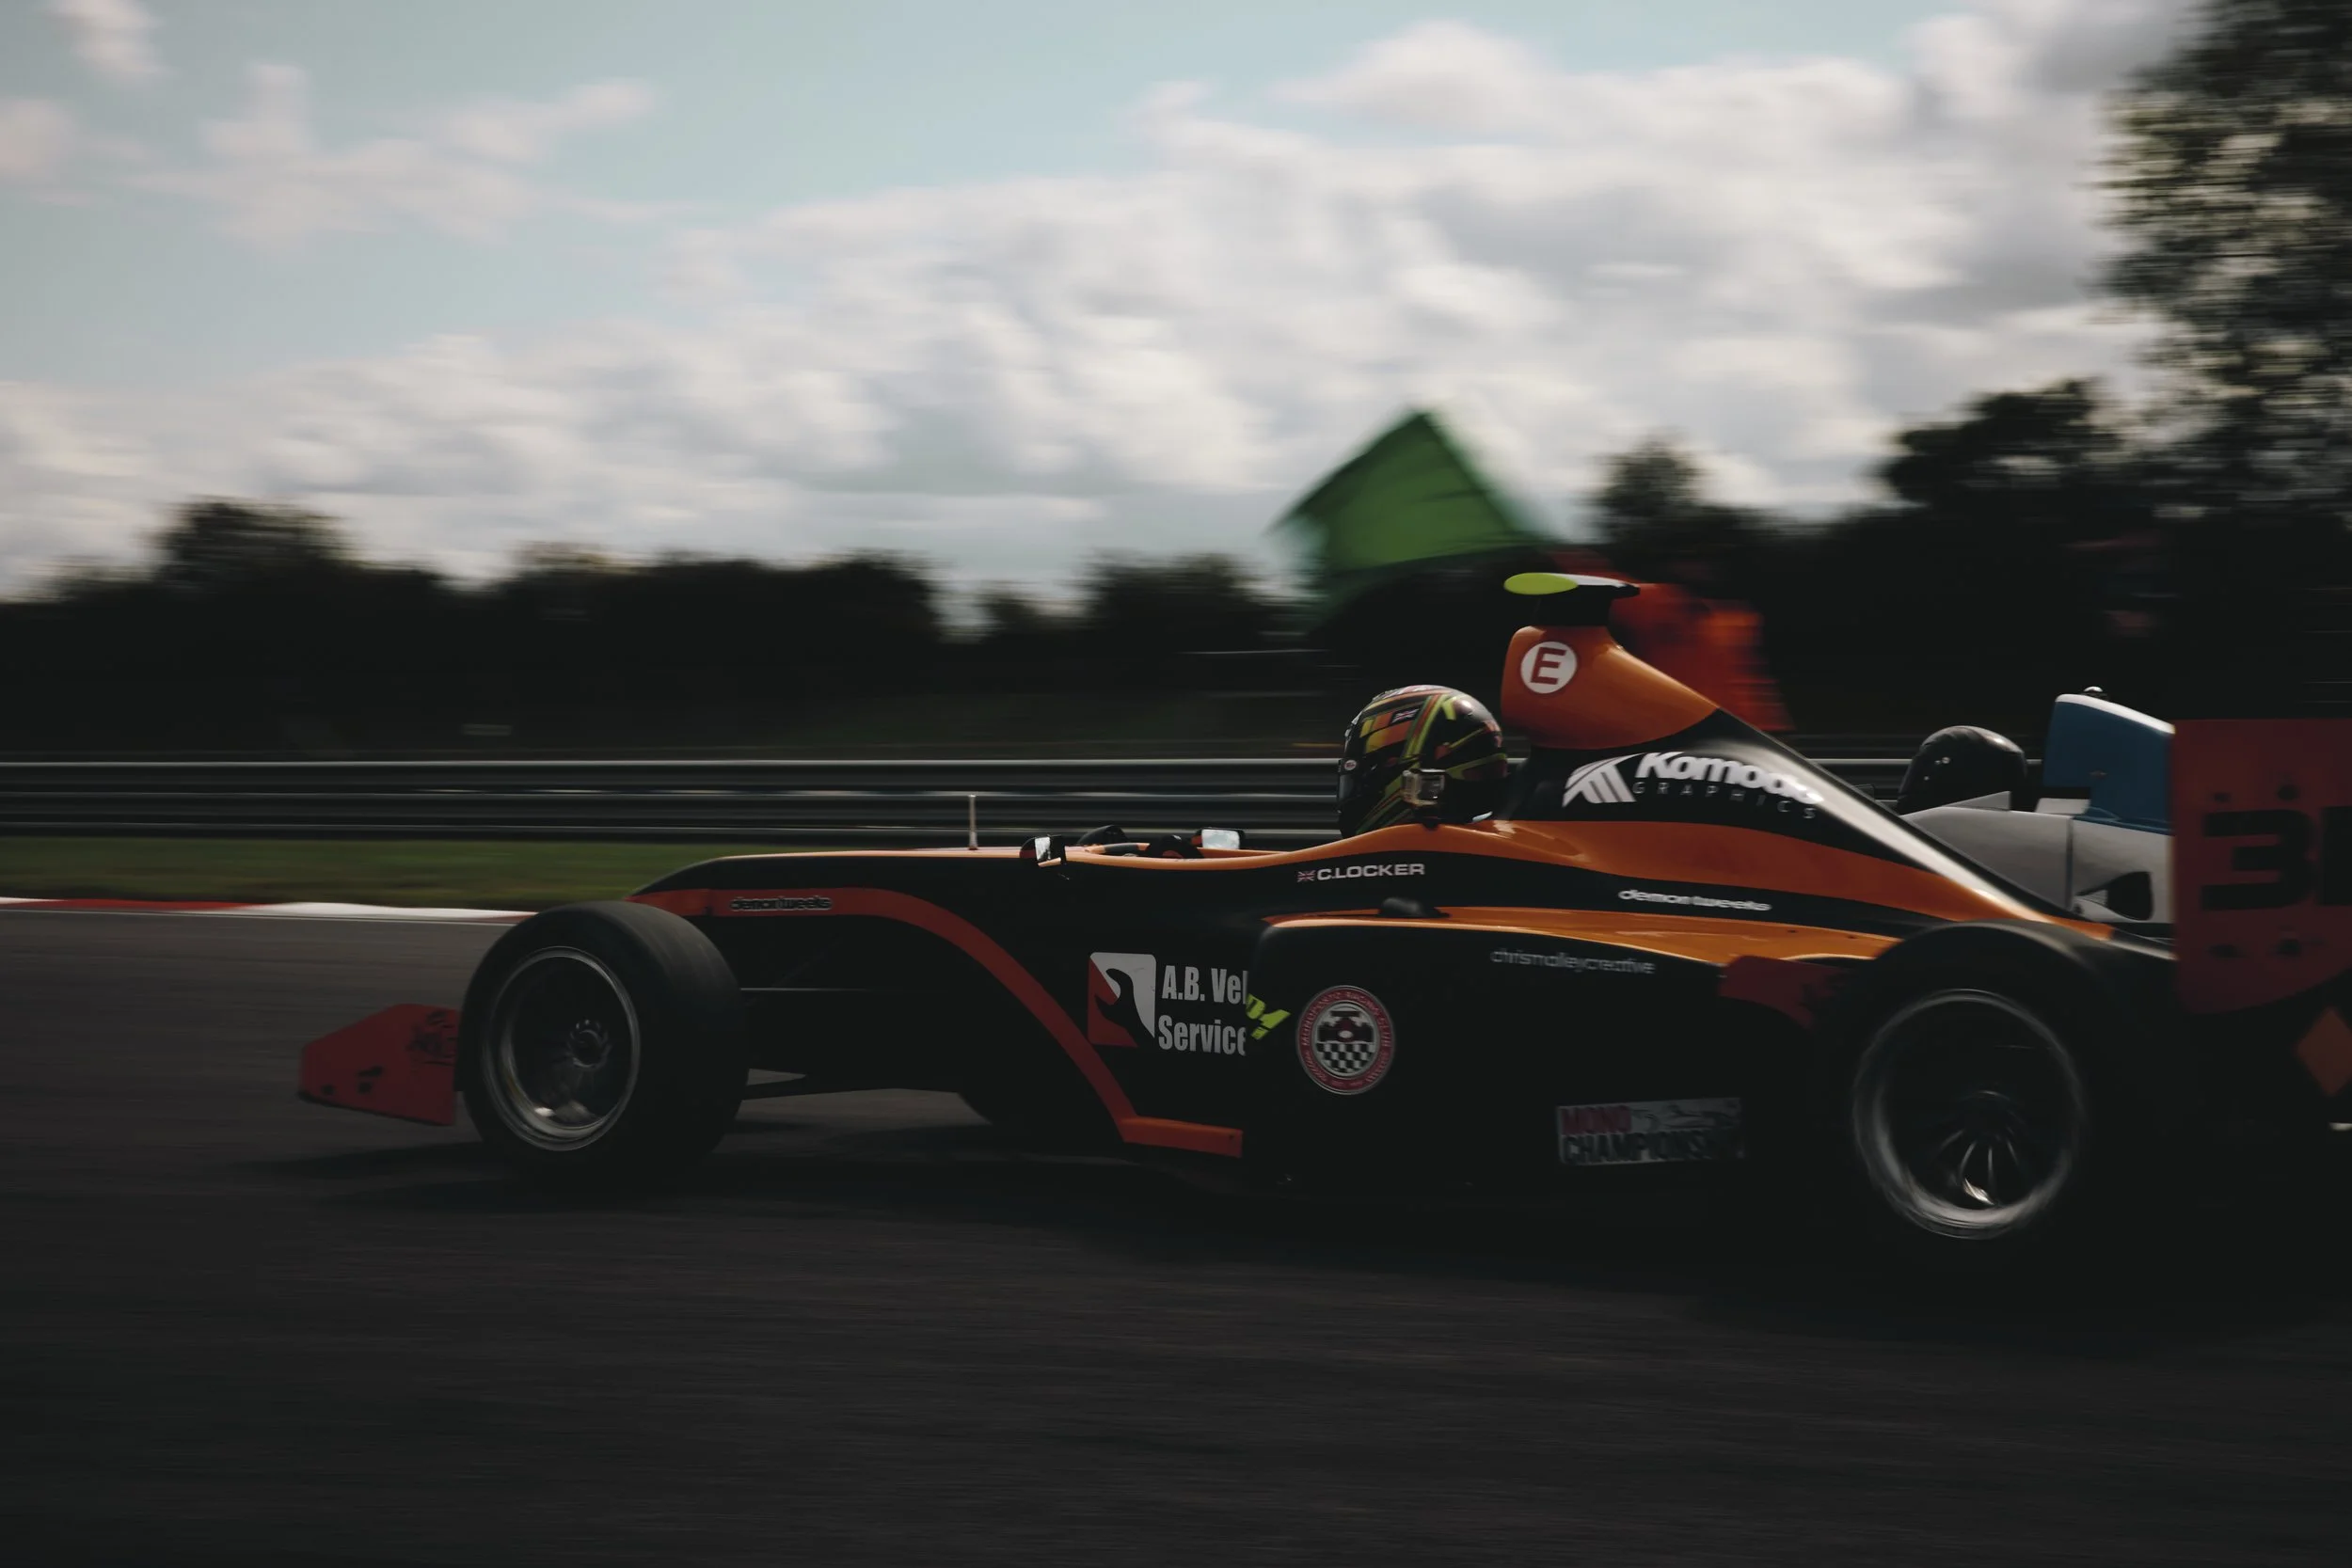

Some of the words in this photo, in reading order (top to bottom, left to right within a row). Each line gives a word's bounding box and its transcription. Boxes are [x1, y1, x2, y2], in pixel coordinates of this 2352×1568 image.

[1530, 646, 1566, 685] E
[1632, 782, 1817, 819] GRAPHICS
[1317, 863, 1425, 881] C.LOCKER
[1161, 964, 1206, 1003] A.B.
[1562, 1130, 1743, 1165] CHAMPIONS
